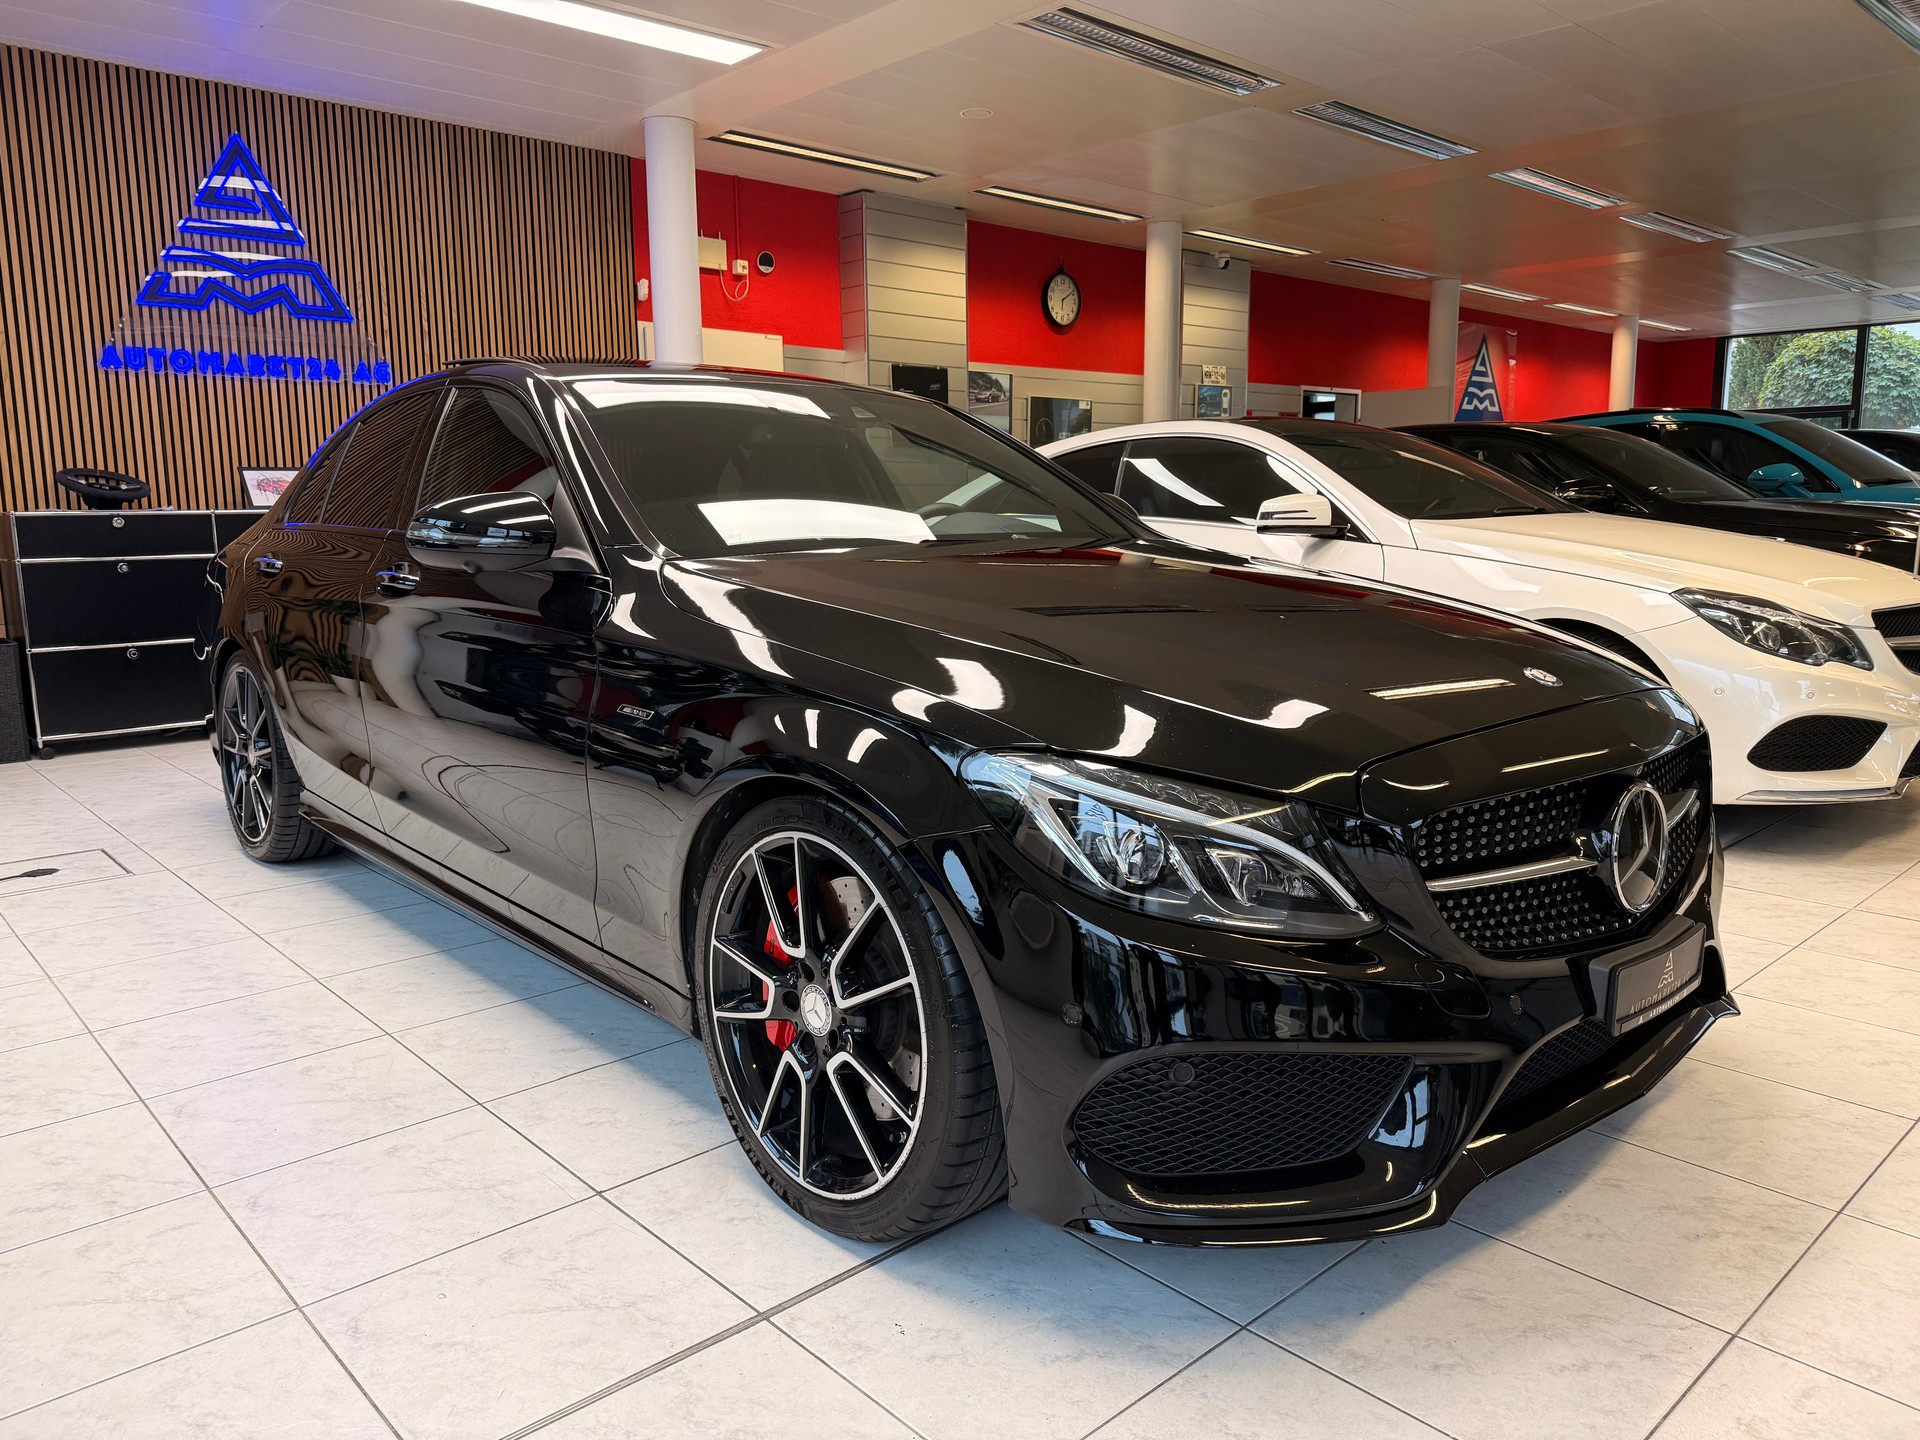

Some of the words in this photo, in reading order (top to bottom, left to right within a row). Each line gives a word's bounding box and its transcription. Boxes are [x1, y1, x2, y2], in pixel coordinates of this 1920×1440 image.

[100, 345, 341, 380] AUTOMARKT24
[353, 361, 392, 384] AG
[721, 1099, 787, 1198] MICHELIN
